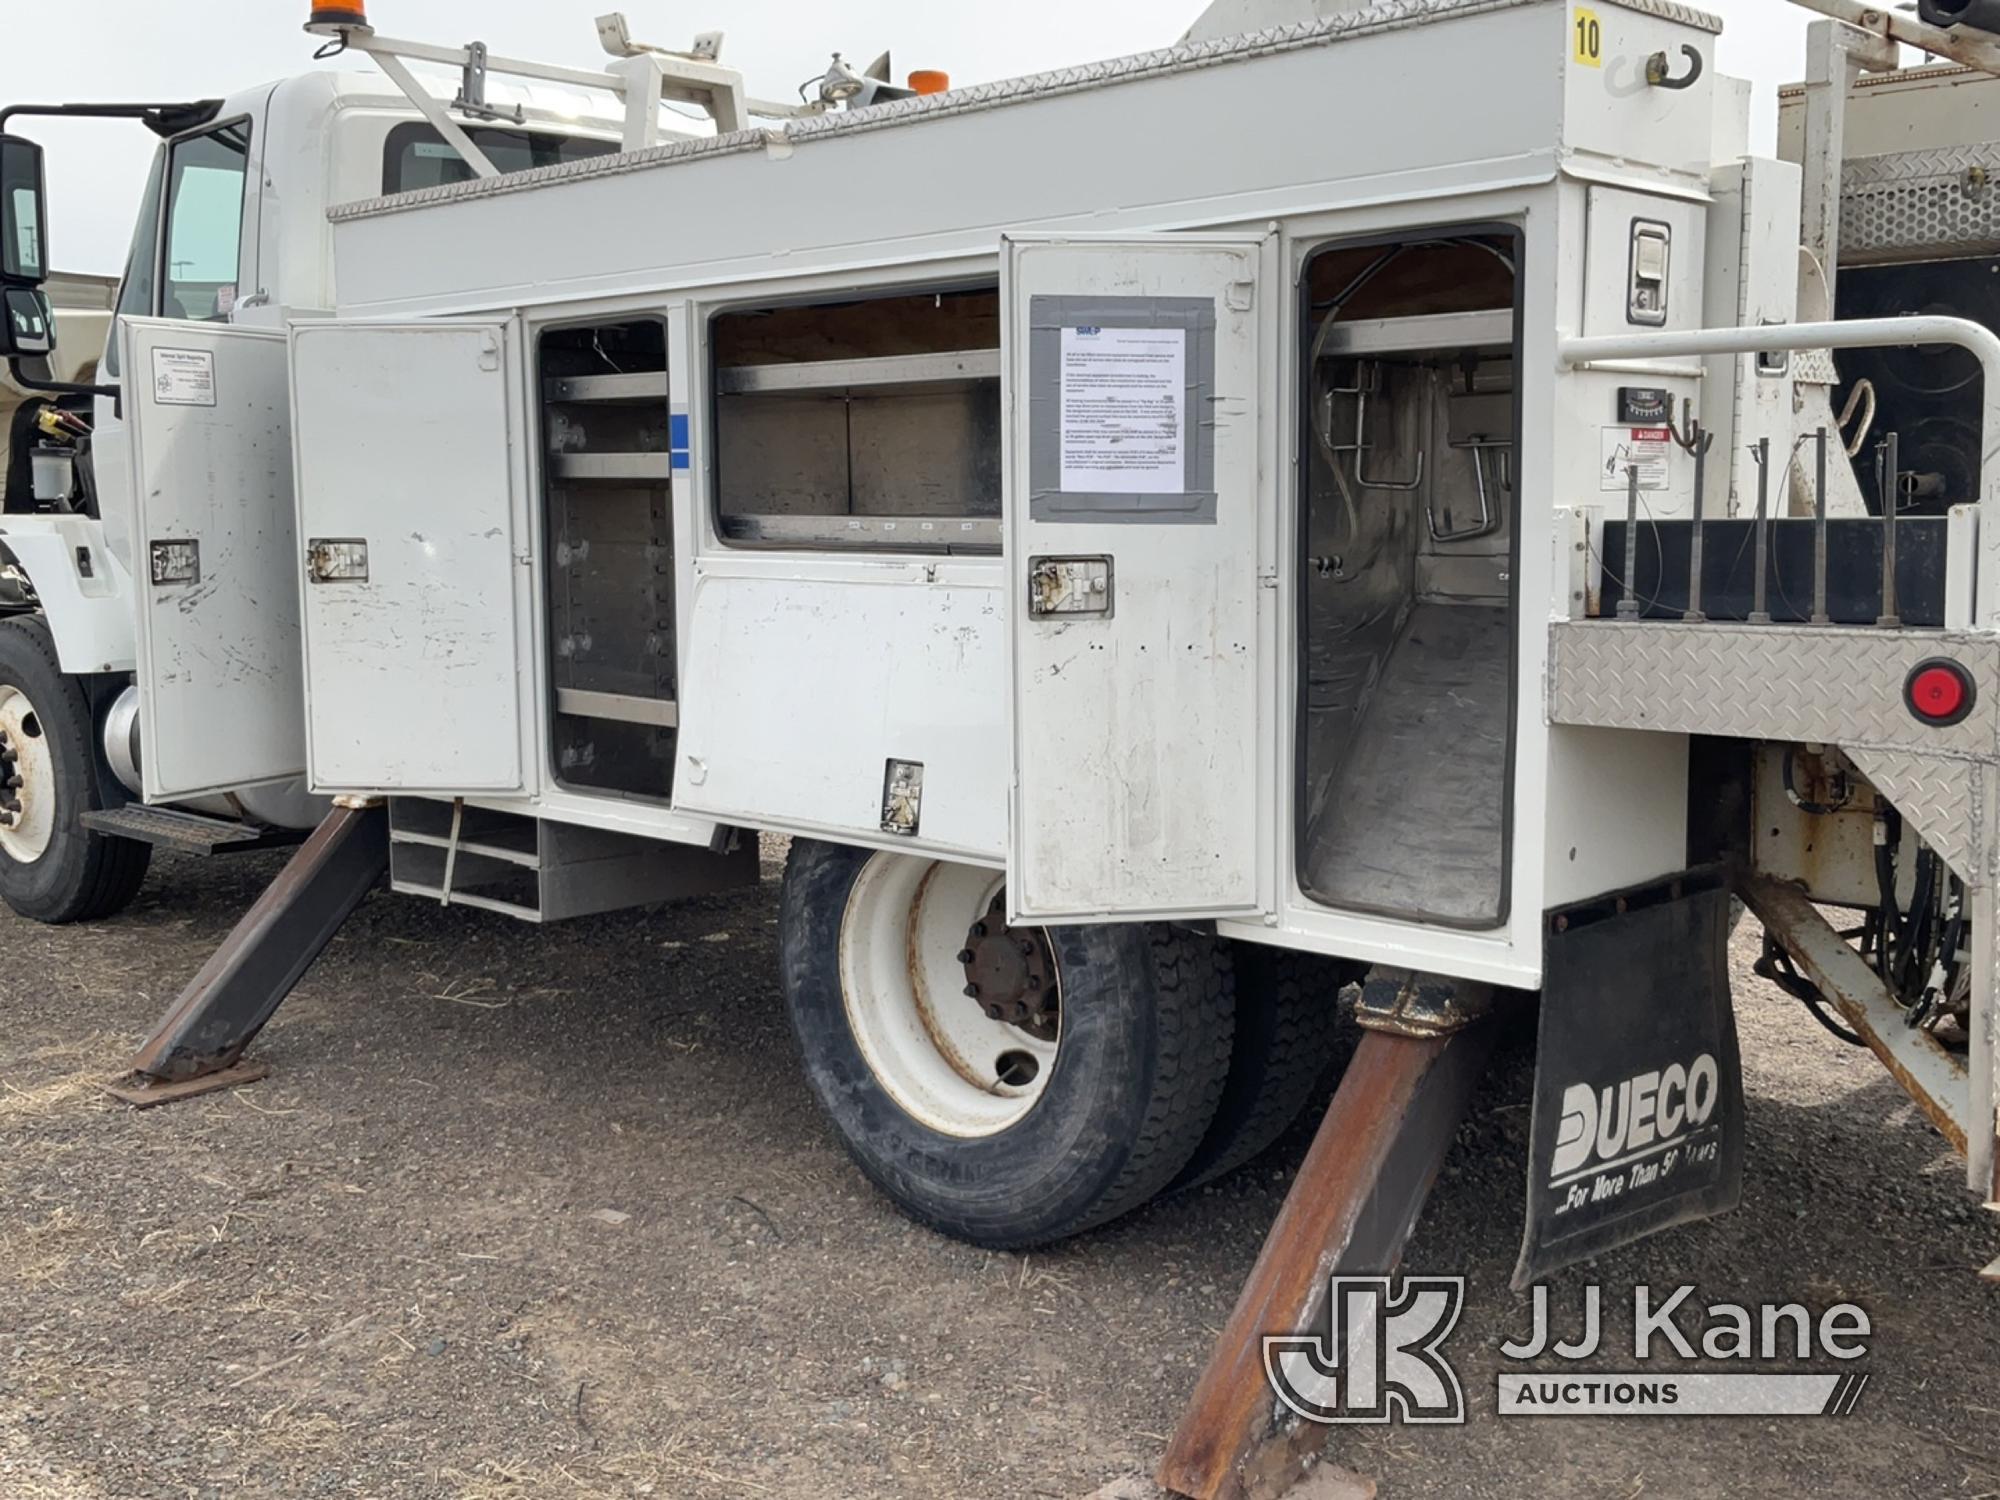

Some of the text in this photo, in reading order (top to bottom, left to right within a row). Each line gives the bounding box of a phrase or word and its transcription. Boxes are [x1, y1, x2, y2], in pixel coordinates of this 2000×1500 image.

[1577, 16, 1600, 58] 10
[1551, 1053, 1718, 1177] DUECO
[1591, 1174, 1624, 1203] More
[1629, 1163, 1658, 1190] Than
